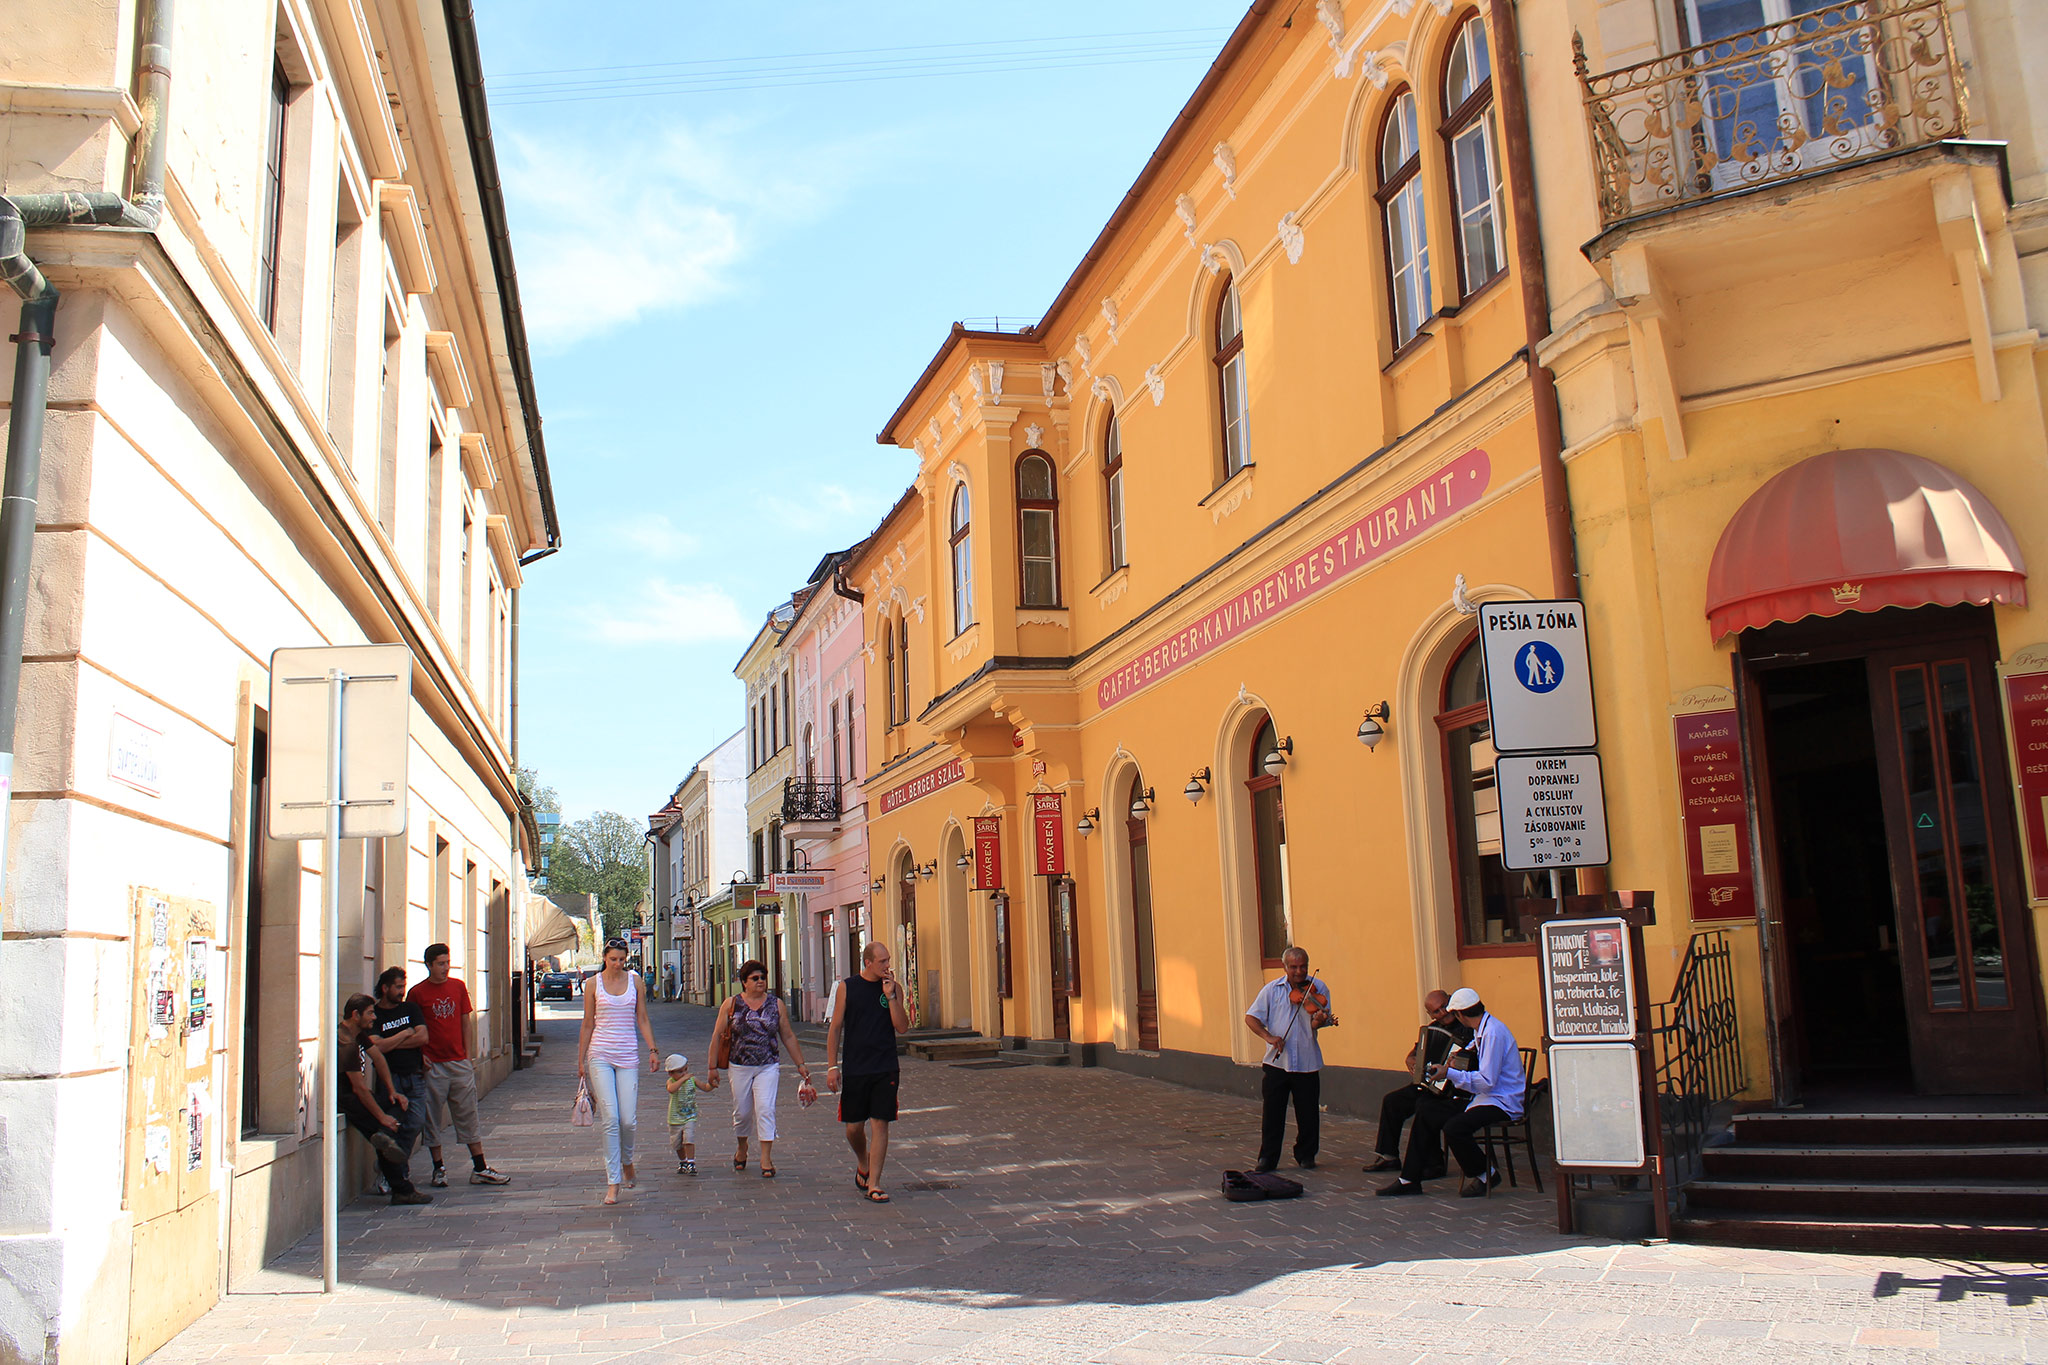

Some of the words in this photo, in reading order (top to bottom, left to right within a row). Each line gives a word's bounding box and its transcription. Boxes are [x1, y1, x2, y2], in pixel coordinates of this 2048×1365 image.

[1144, 627, 1198, 679] BERGER
[1295, 471, 1453, 593] RESTAURANT
[1489, 612, 1532, 631] PEŠIA
[1536, 609, 1577, 629] ZÓNA
[1682, 694, 1727, 709] Prezident
[1688, 727, 1728, 740] KAVIAREŇ
[1693, 750, 1728, 763] PIVÁREŇ
[1536, 759, 1567, 770] OKREM
[1528, 774, 1580, 786] DOPRAVNEJ
[1690, 771, 1735, 785] CUKRÁREŇ
[908, 773, 935, 799] BERGER
[1533, 790, 1573, 801] OBSLUHY
[1688, 794, 1742, 806] REŠTAURÁCIA
[1526, 807, 1532, 817] A
[1535, 805, 1583, 817] CYKLISTOV
[1524, 820, 1586, 833] ZÁSOBOVANIE
[1043, 820, 1055, 872] PIVÁREŇ
[1575, 838, 1581, 846] a
[982, 841, 993, 887] PIVÁREŇ
[1549, 930, 1588, 950] TANKOVÉ
[1552, 951, 1572, 967] PIVO
[382, 1016, 410, 1031] ABSOLUT
